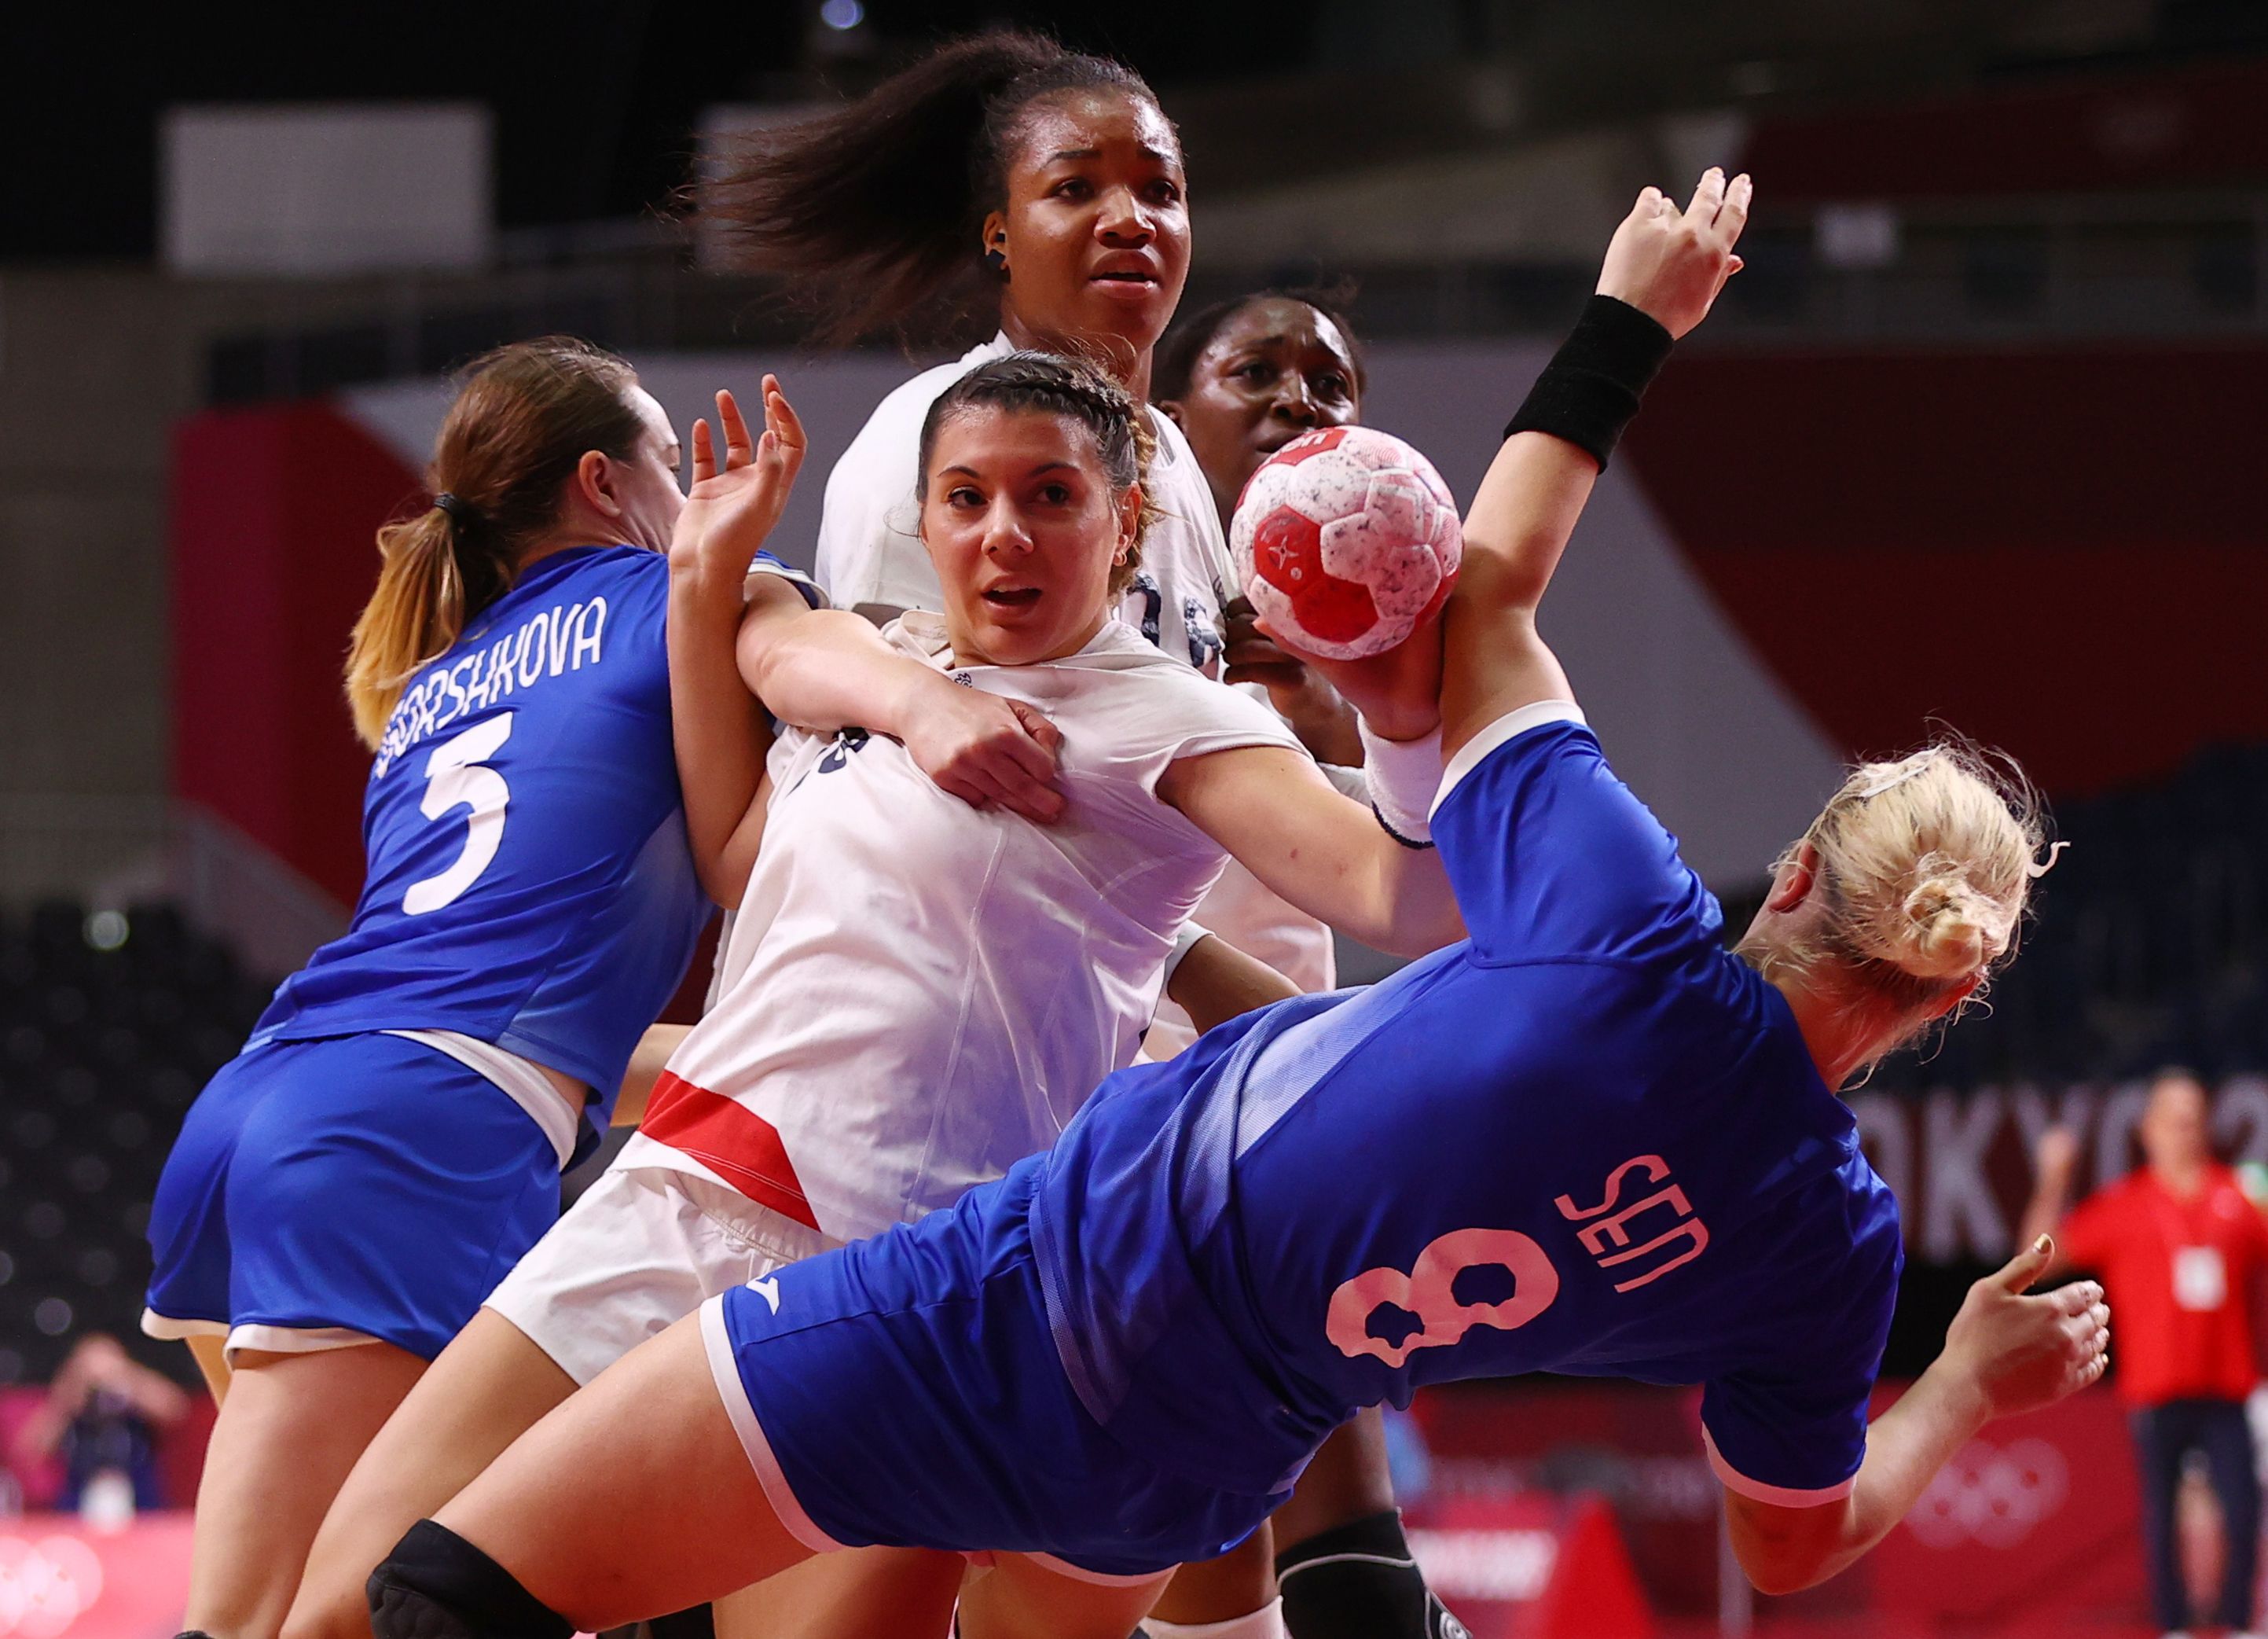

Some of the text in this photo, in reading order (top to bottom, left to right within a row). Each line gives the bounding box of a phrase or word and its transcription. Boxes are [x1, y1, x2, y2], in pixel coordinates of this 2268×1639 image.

[402, 711, 513, 917] 5
[1554, 1154, 1709, 1293] SEN
[1326, 1228, 1559, 1369] 8
